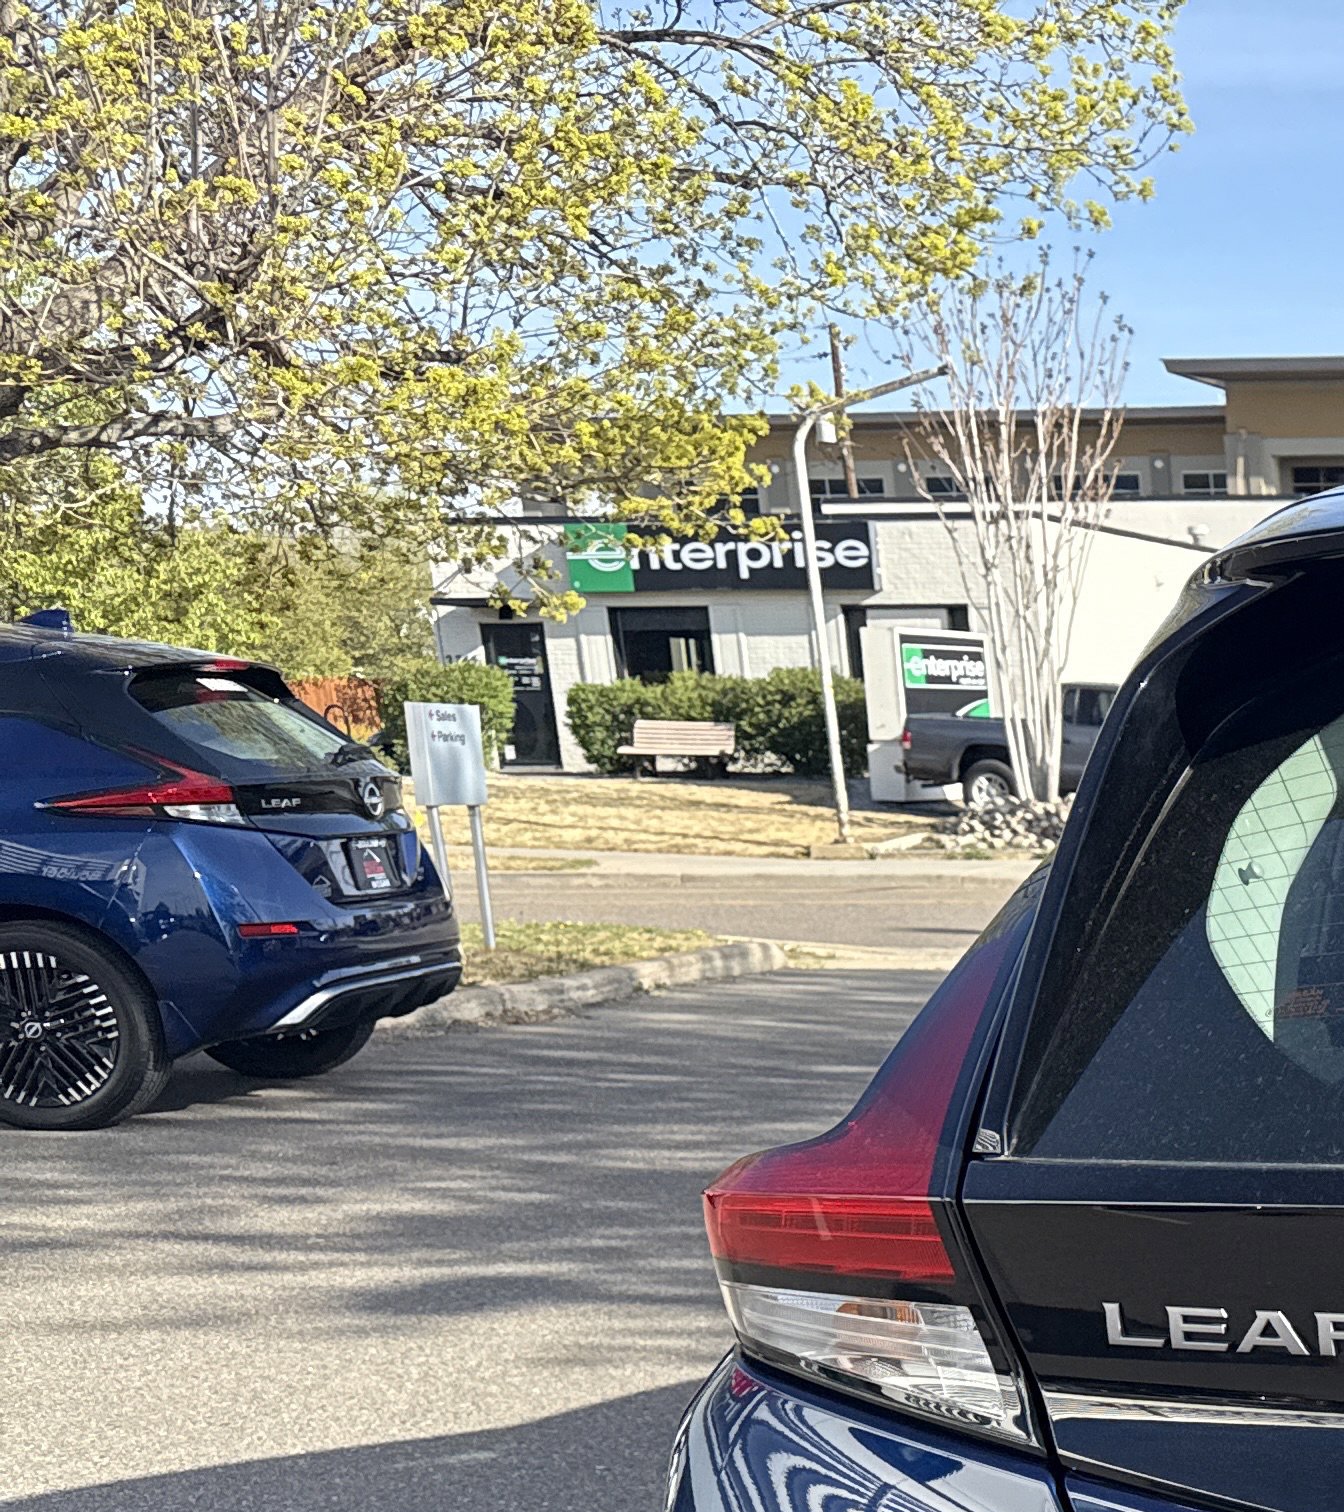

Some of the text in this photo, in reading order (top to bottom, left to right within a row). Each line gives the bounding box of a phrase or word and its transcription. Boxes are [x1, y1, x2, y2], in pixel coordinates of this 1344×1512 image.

[566, 530, 869, 580] enterprise
[904, 655, 984, 682] enterprise
[435, 709, 456, 722] Sales
[437, 730, 465, 746] Parking
[260, 798, 301, 809] LEAF
